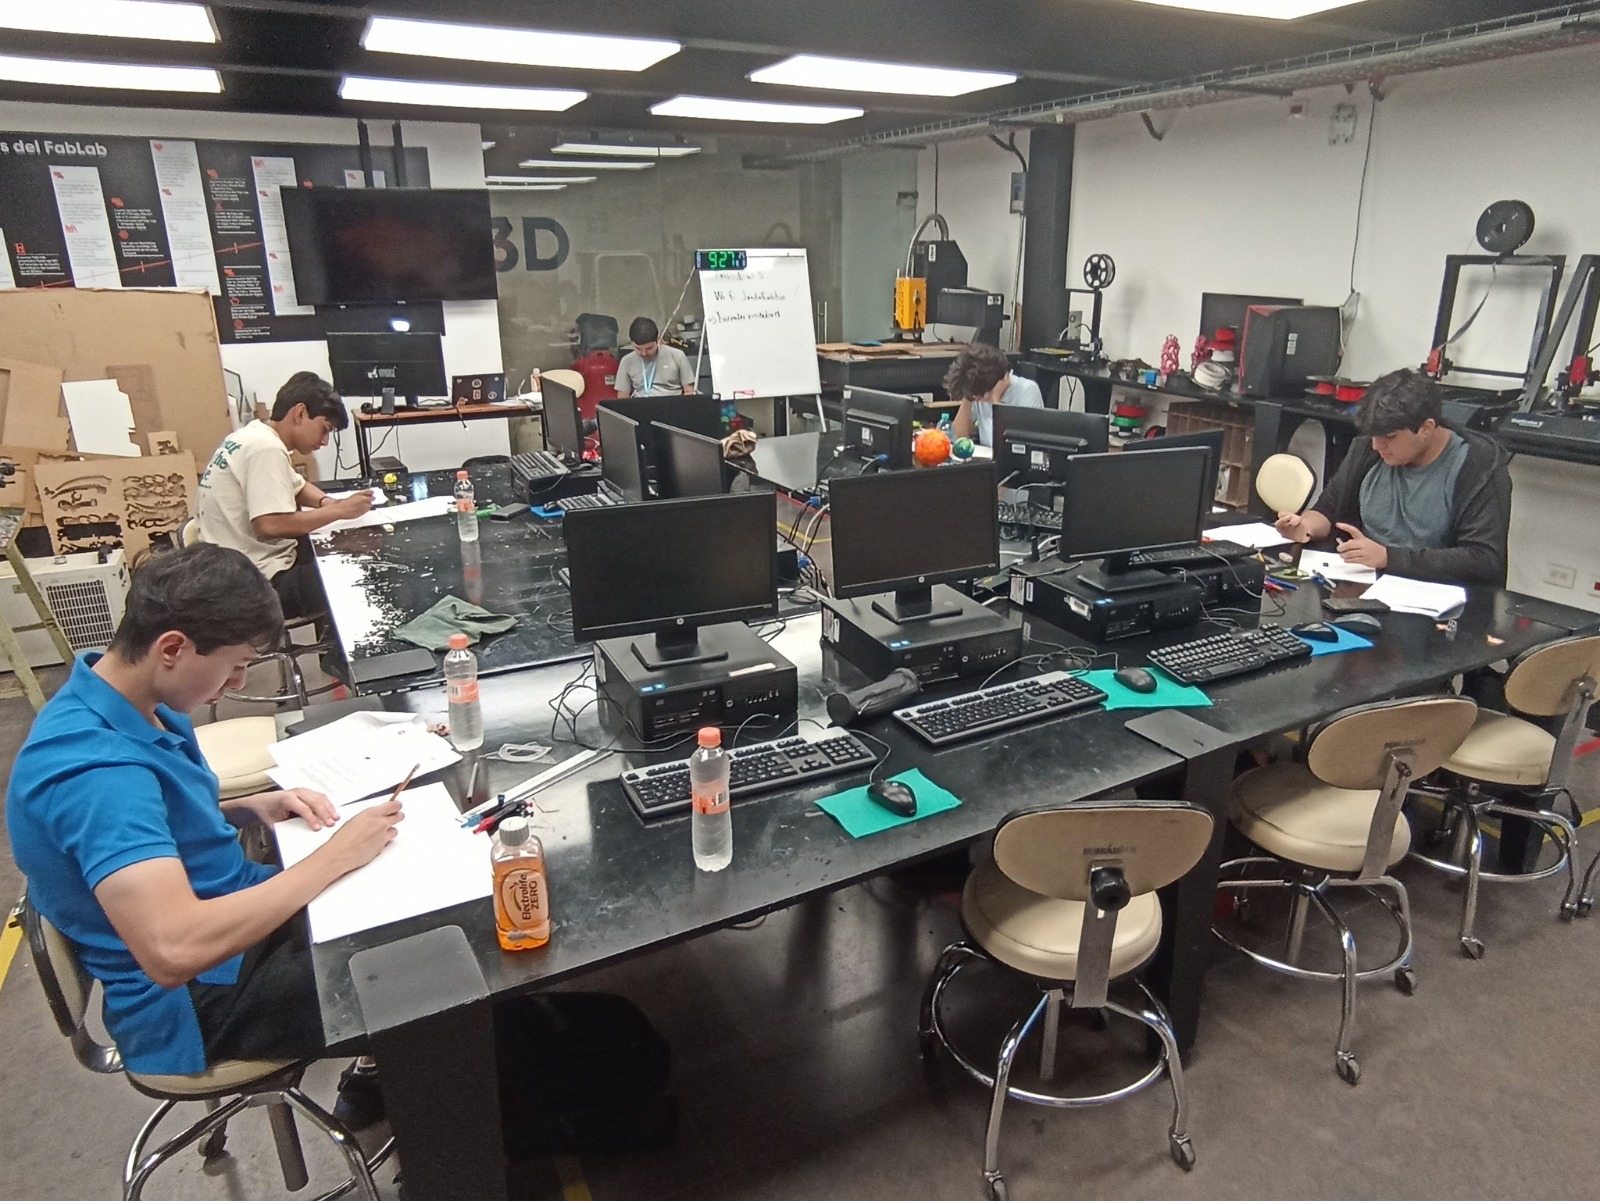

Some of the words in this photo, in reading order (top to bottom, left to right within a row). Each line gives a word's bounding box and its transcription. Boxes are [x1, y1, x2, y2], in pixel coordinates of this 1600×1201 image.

[13, 140, 40, 154] del
[44, 140, 107, 157] FabLab
[492, 216, 569, 272] 3D
[519, 873, 531, 920] Electrolife
[529, 881, 539, 910] ZERO
